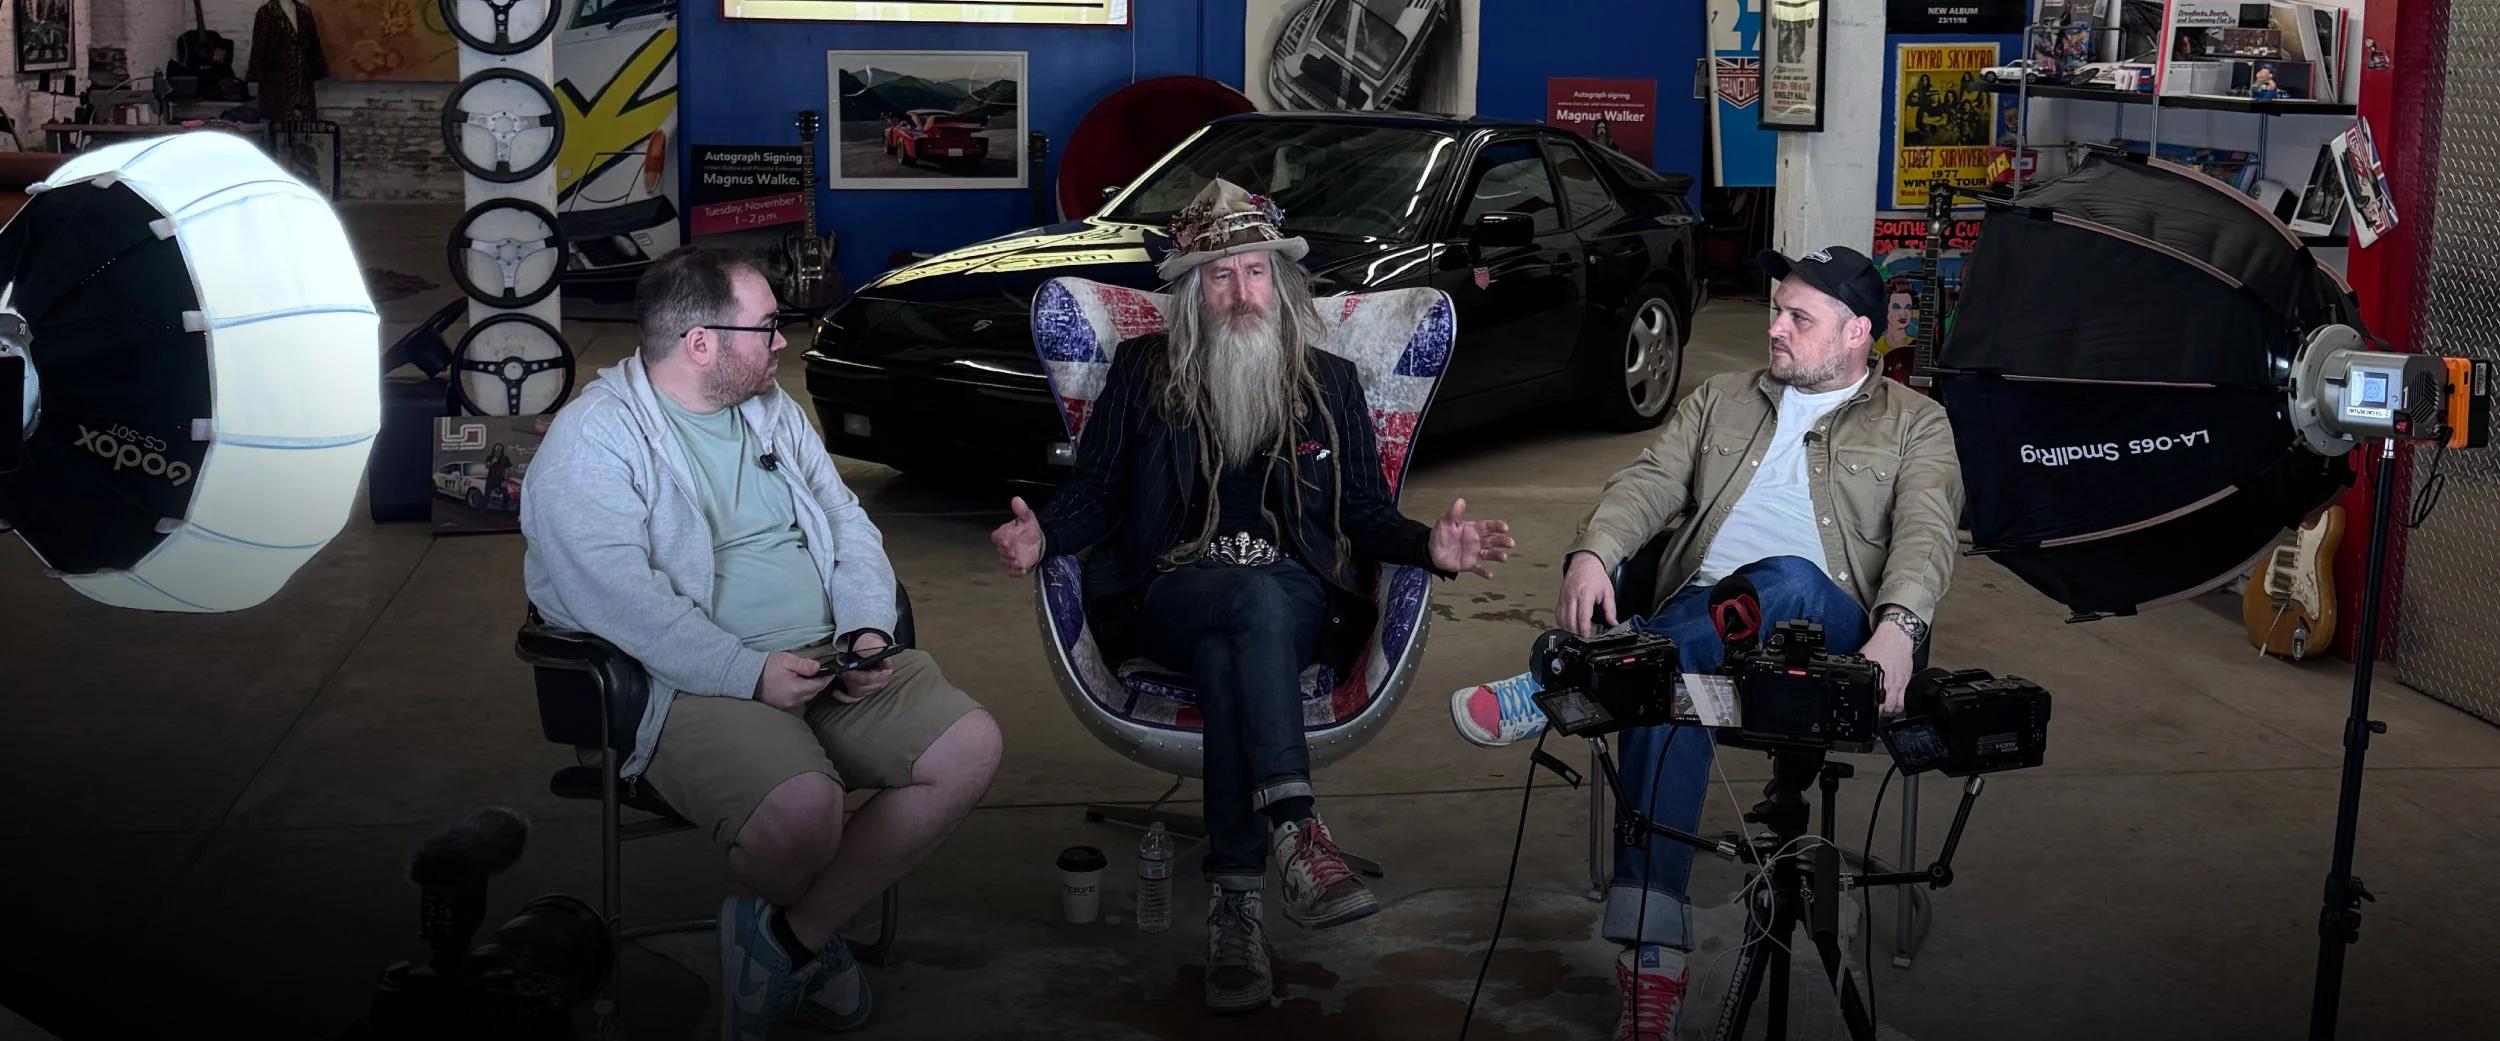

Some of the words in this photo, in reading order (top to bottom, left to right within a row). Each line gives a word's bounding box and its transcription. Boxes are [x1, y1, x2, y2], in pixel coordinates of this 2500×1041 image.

[1928, 7, 1947, 15] NEW
[1949, 7, 1979, 15] ALBUM
[1906, 49, 1943, 69] LYNYRD
[1948, 49, 1994, 69] SKYNYRD
[1573, 91, 1606, 100] Autograph
[1607, 92, 1631, 100] signing
[1556, 109, 1602, 123] Magnus
[1604, 110, 1645, 122] Walker
[704, 150, 761, 165] Autograph
[763, 151, 803, 165] Signing
[1900, 150, 1936, 168] STREET
[1940, 149, 1990, 168] SURVIVERS
[704, 172, 754, 188] Magnus
[1932, 170, 1959, 179] 1977
[1956, 177, 1987, 187] TOUR
[704, 205, 743, 217] Tuesday,
[745, 197, 796, 211] November
[734, 216, 739, 225] 1
[1873, 239, 1899, 255] ON
[1948, 238, 1977, 252] SK
[106, 424, 167, 452] CS-50T
[73, 424, 192, 487] Godox
[2020, 442, 2120, 466] SmallRig
